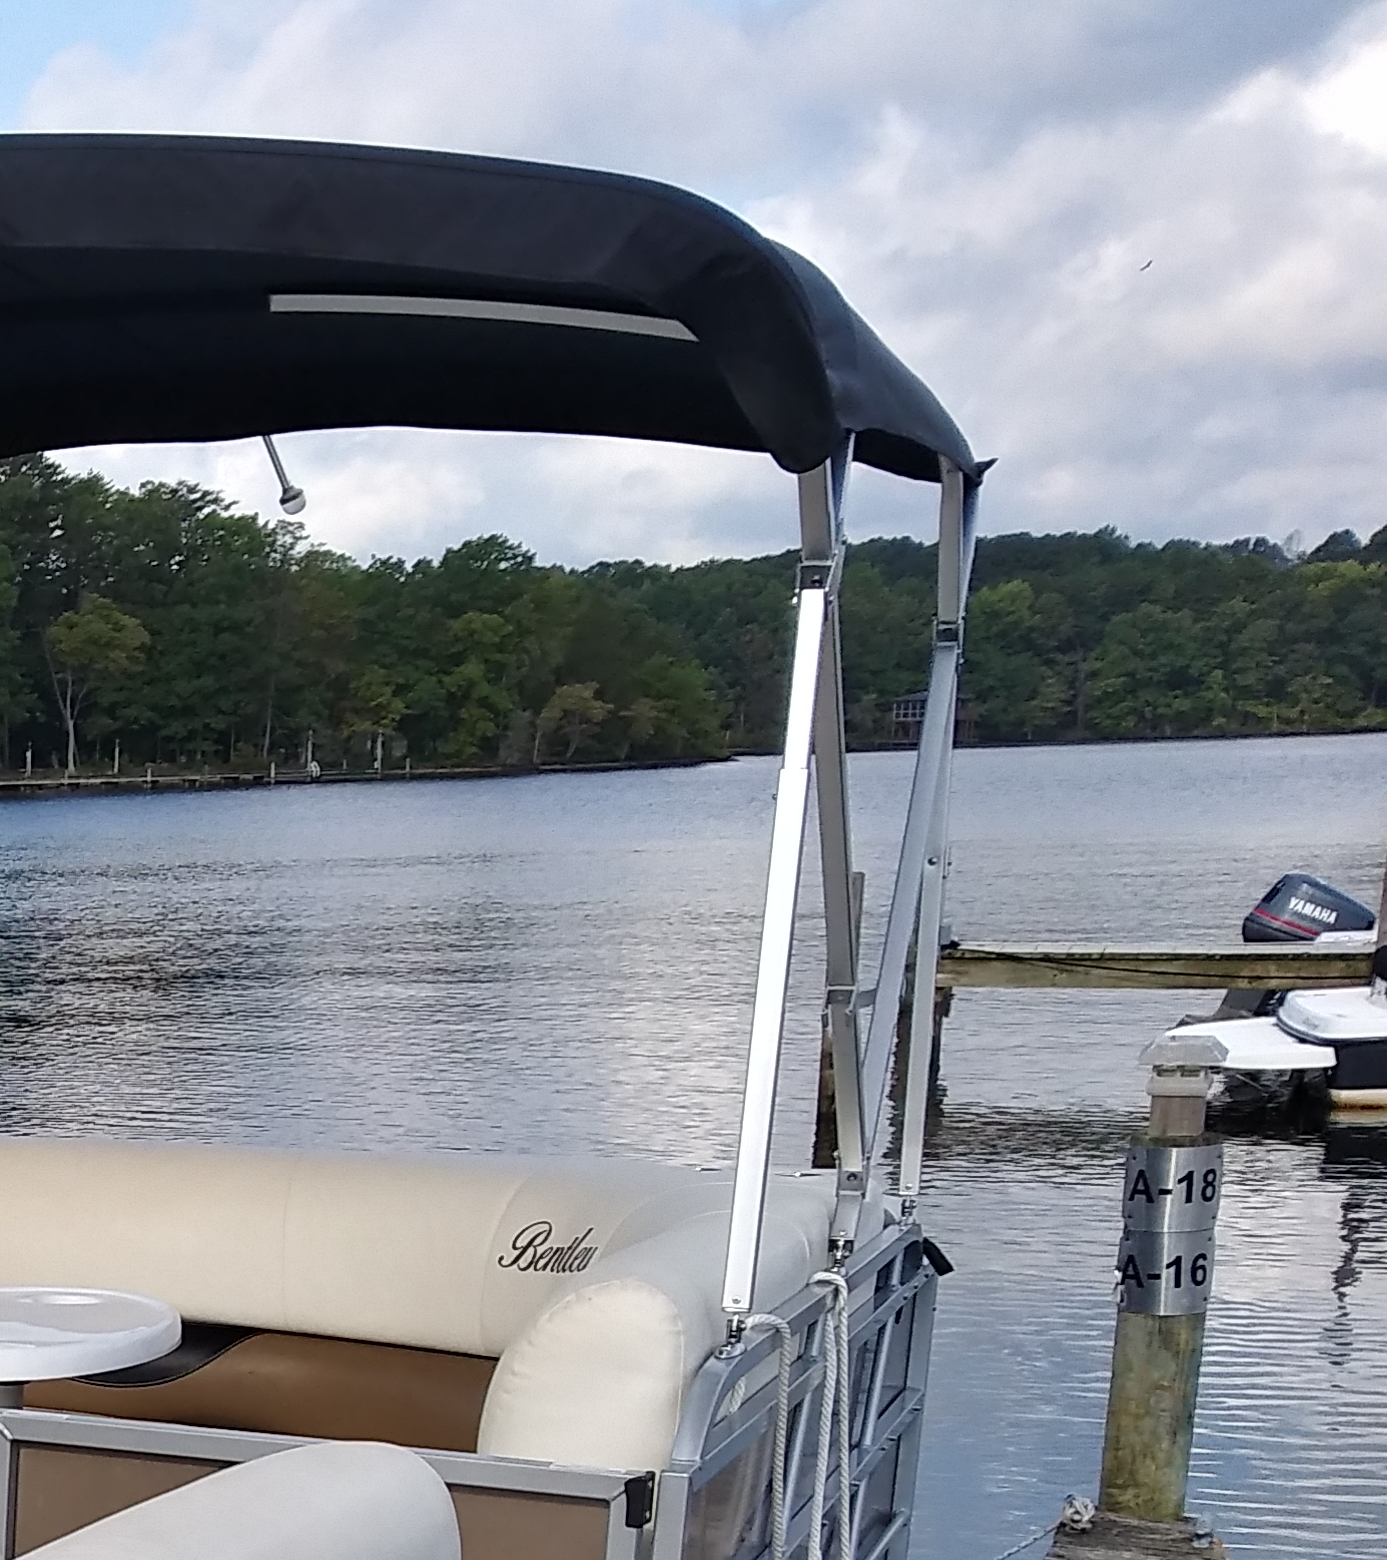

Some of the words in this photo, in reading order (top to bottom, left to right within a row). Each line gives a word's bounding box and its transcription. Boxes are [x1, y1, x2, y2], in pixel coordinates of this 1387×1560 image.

[1288, 896, 1338, 925] YAMAHA
[1128, 1168, 1217, 1204] A-18
[1120, 1252, 1208, 1289] A-16
